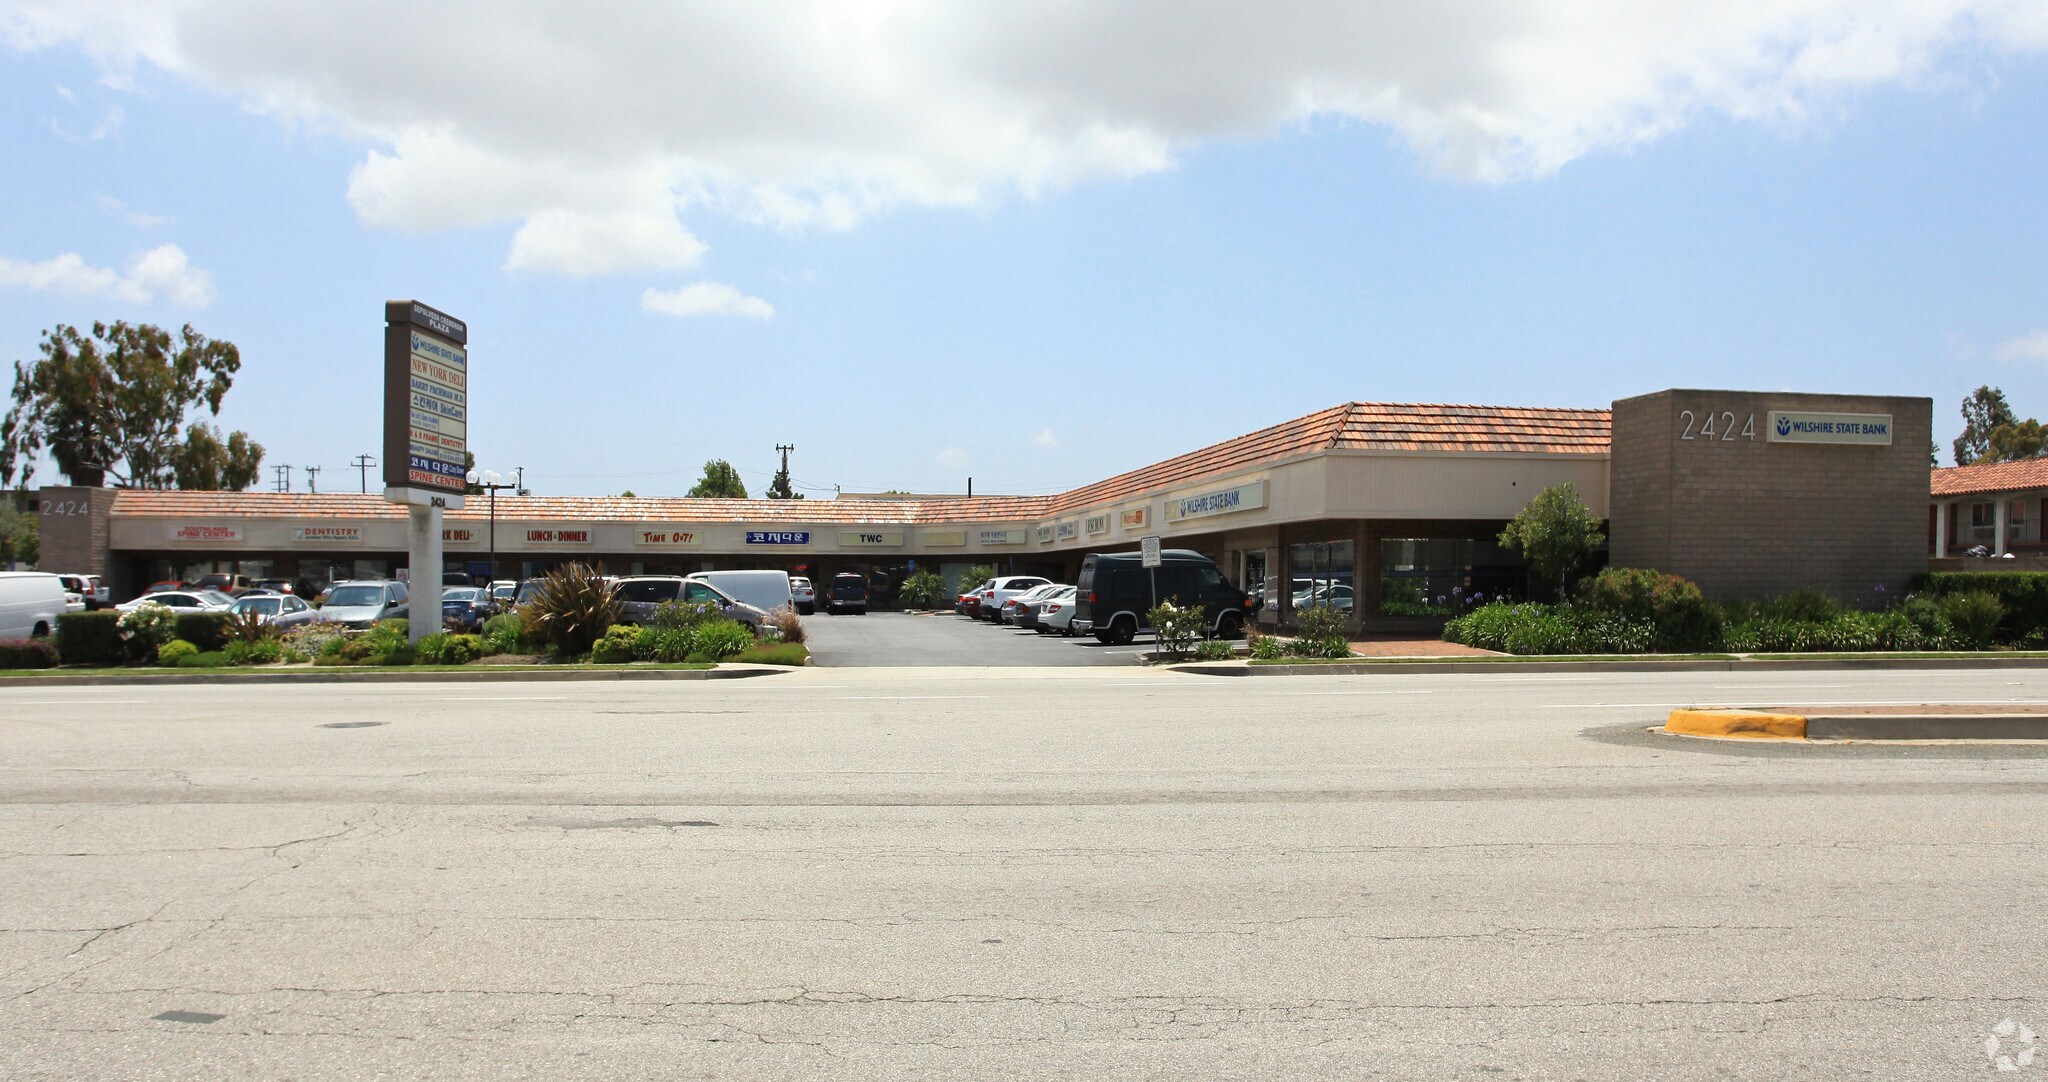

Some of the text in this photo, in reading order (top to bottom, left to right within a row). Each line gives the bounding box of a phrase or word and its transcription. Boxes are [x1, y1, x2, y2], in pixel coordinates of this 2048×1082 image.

[429, 319, 450, 334] PLAZA
[420, 341, 465, 365] WILSHIRE STATE BANK
[412, 359, 464, 387] NEW YORK DELI
[413, 395, 438, 412] 스킨케어
[1679, 410, 1756, 441] 2424
[1793, 421, 1887, 435] WILSHIRE STATE BANK
[441, 437, 463, 448] DENTISTRY
[410, 470, 465, 489] SPINE CENTER
[42, 500, 88, 516] 2424
[430, 496, 446, 508] 2424
[1187, 490, 1240, 513] WILSHIRE STATE BANK
[453, 530, 470, 541] DELI
[527, 530, 553, 542] LUNCH
[558, 531, 588, 542] DINNER
[860, 534, 883, 543] TWC
